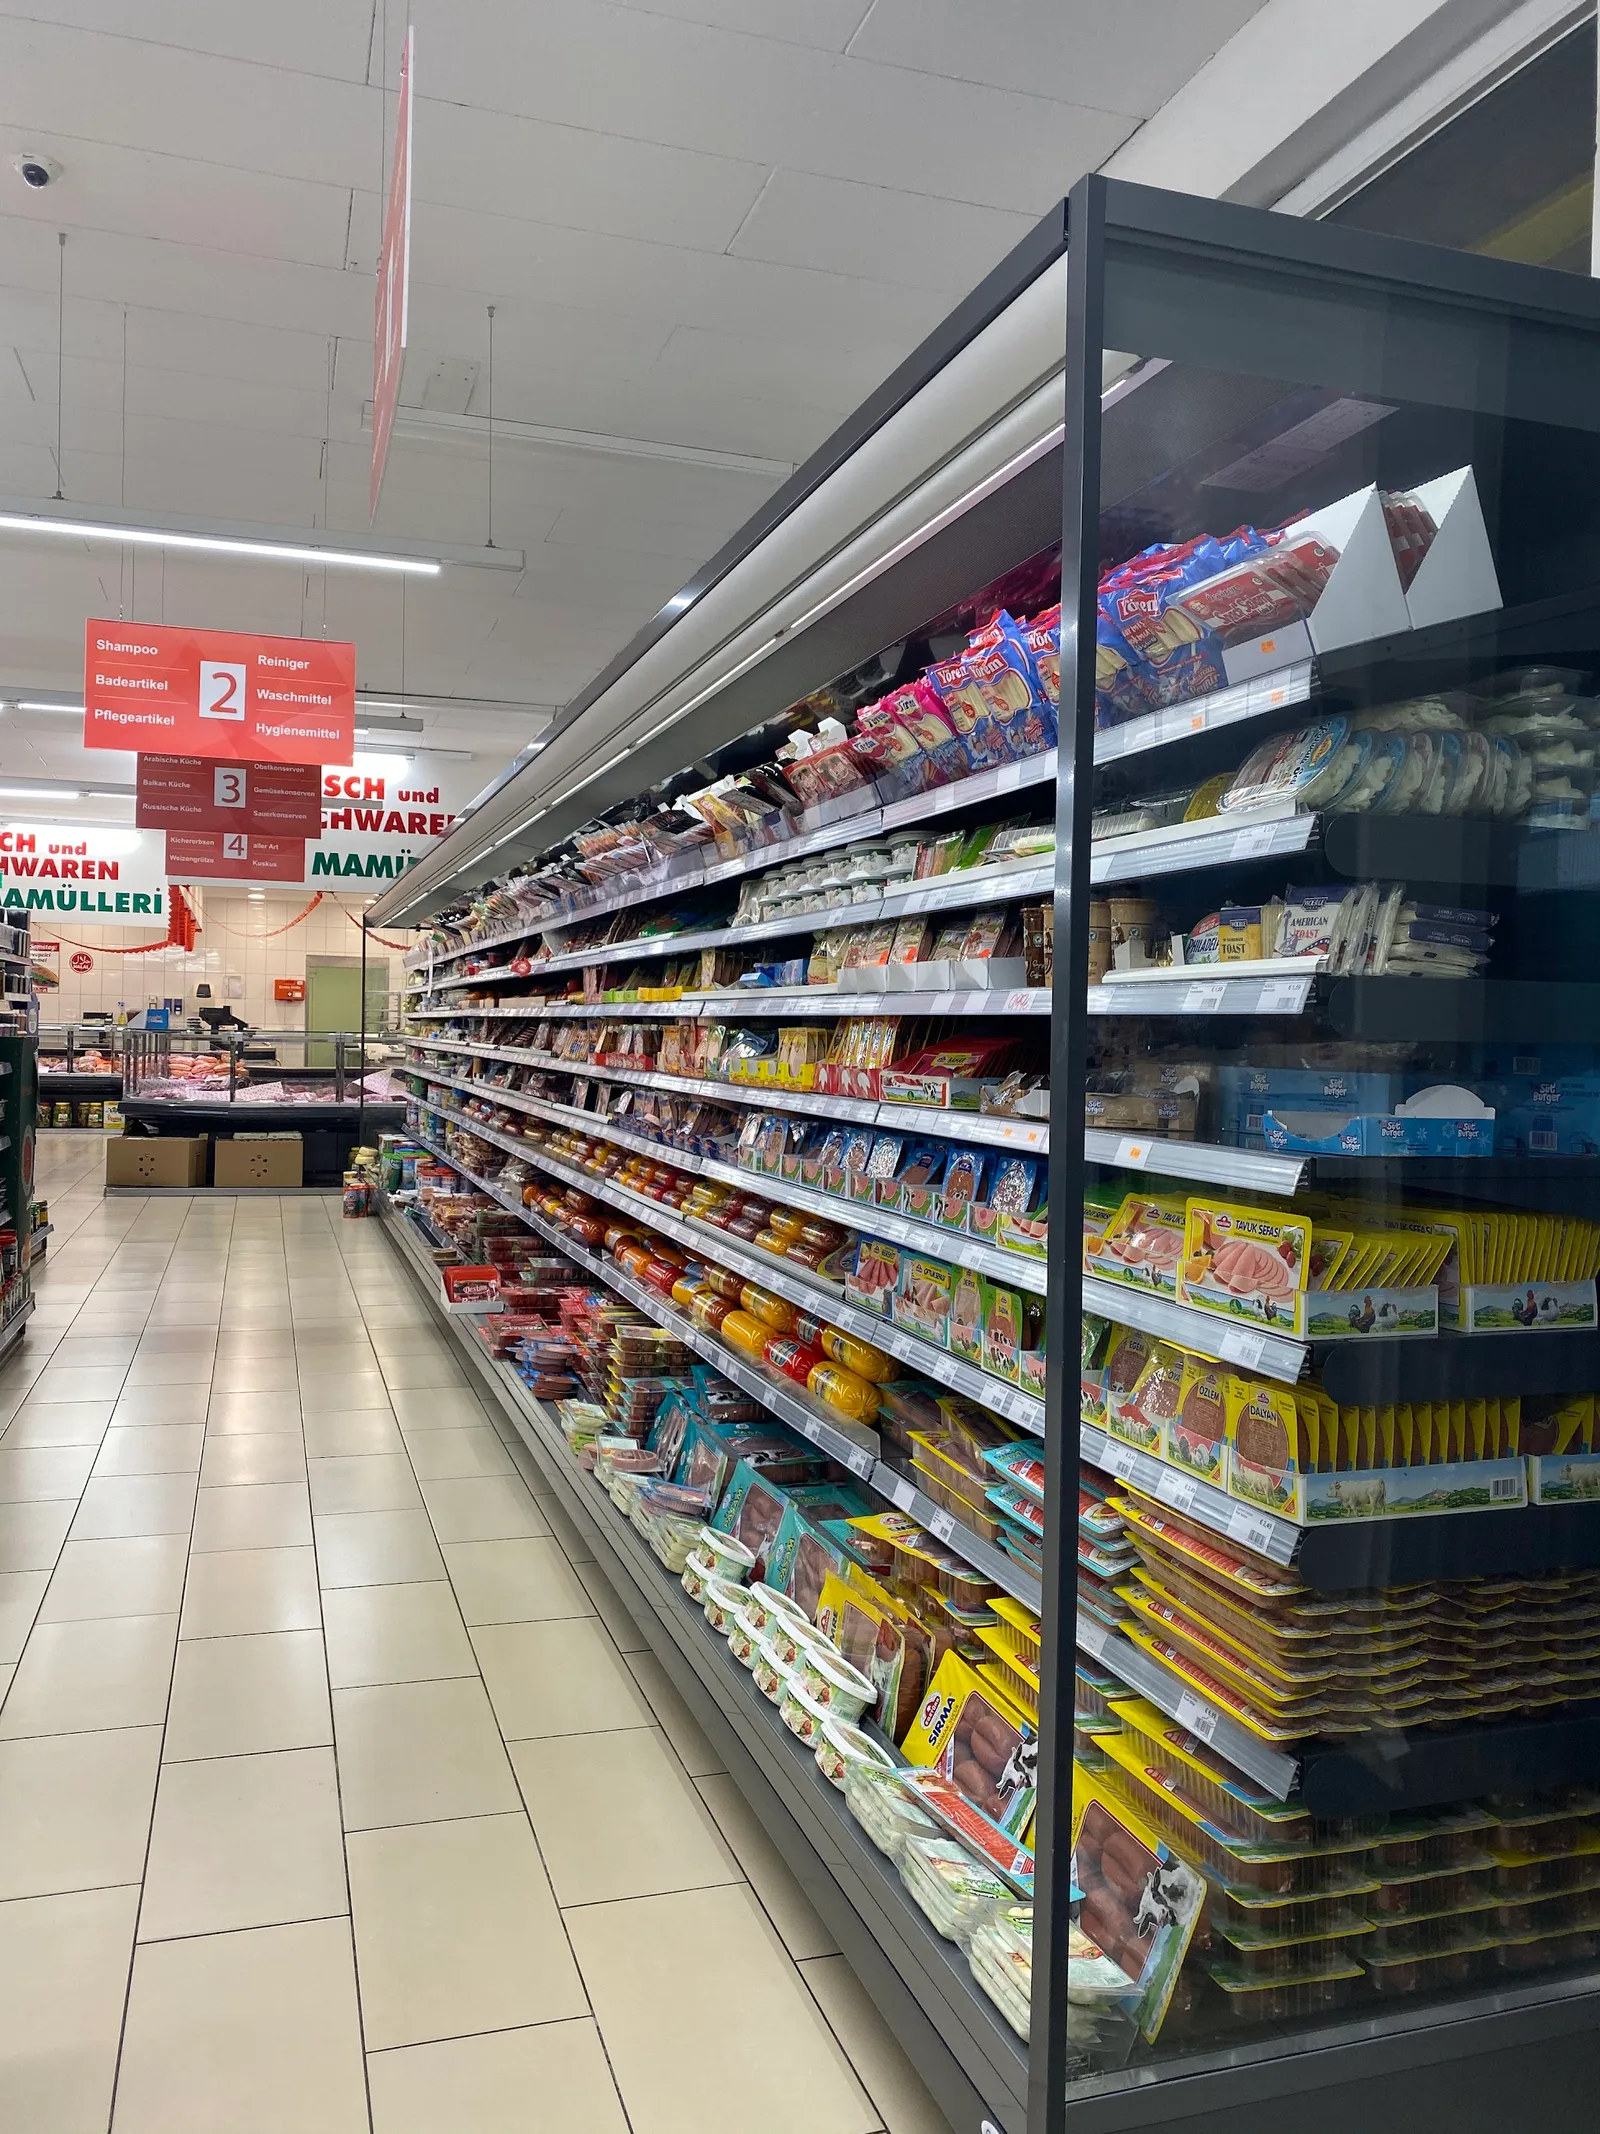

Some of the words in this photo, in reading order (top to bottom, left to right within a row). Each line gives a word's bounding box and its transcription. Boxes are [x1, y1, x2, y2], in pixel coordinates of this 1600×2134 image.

[96, 639, 158, 656] Shampoo
[258, 655, 310, 670] Reiniger
[968, 658, 1004, 679] Yörem
[95, 674, 168, 691] Badeartikel
[209, 671, 237, 714] 2
[256, 689, 332, 705] Waschmittel
[94, 709, 175, 726] Pflegeartikel
[256, 722, 340, 740] Hygienemittel
[143, 755, 178, 765] Arabische
[179, 758, 202, 766] Küche
[254, 763, 305, 773] Obstkonserven
[142, 779, 167, 787] Balkan
[168, 780, 191, 789] Küche
[221, 774, 240, 804] 3
[323, 774, 385, 800] SCH
[398, 787, 440, 804] und
[253, 786, 316, 797] Gemüsekonserven
[142, 803, 178, 812] Russische
[179, 805, 202, 813] Küche
[253, 810, 307, 820] Sauerkonserven
[321, 808, 456, 836] HWARE
[170, 837, 215, 846] Kichererbsen
[228, 835, 245, 857] 4
[48, 842, 87, 856] und
[170, 854, 215, 864] Weizengrütze
[252, 860, 278, 868] Kuskus
[1290, 916, 1328, 927] AMERICAN
[1294, 929, 1319, 939] TOAST
[1222, 943, 1245, 954] TOAST
[1324, 1086, 1347, 1098] Burger
[1533, 1092, 1561, 1105] Burger
[1235, 1219, 1258, 1233] TAVUK
[1258, 1223, 1281, 1238] SEFASI
[1250, 1405, 1277, 1422] DALYAN
[928, 1697, 956, 1747] SIRMA
